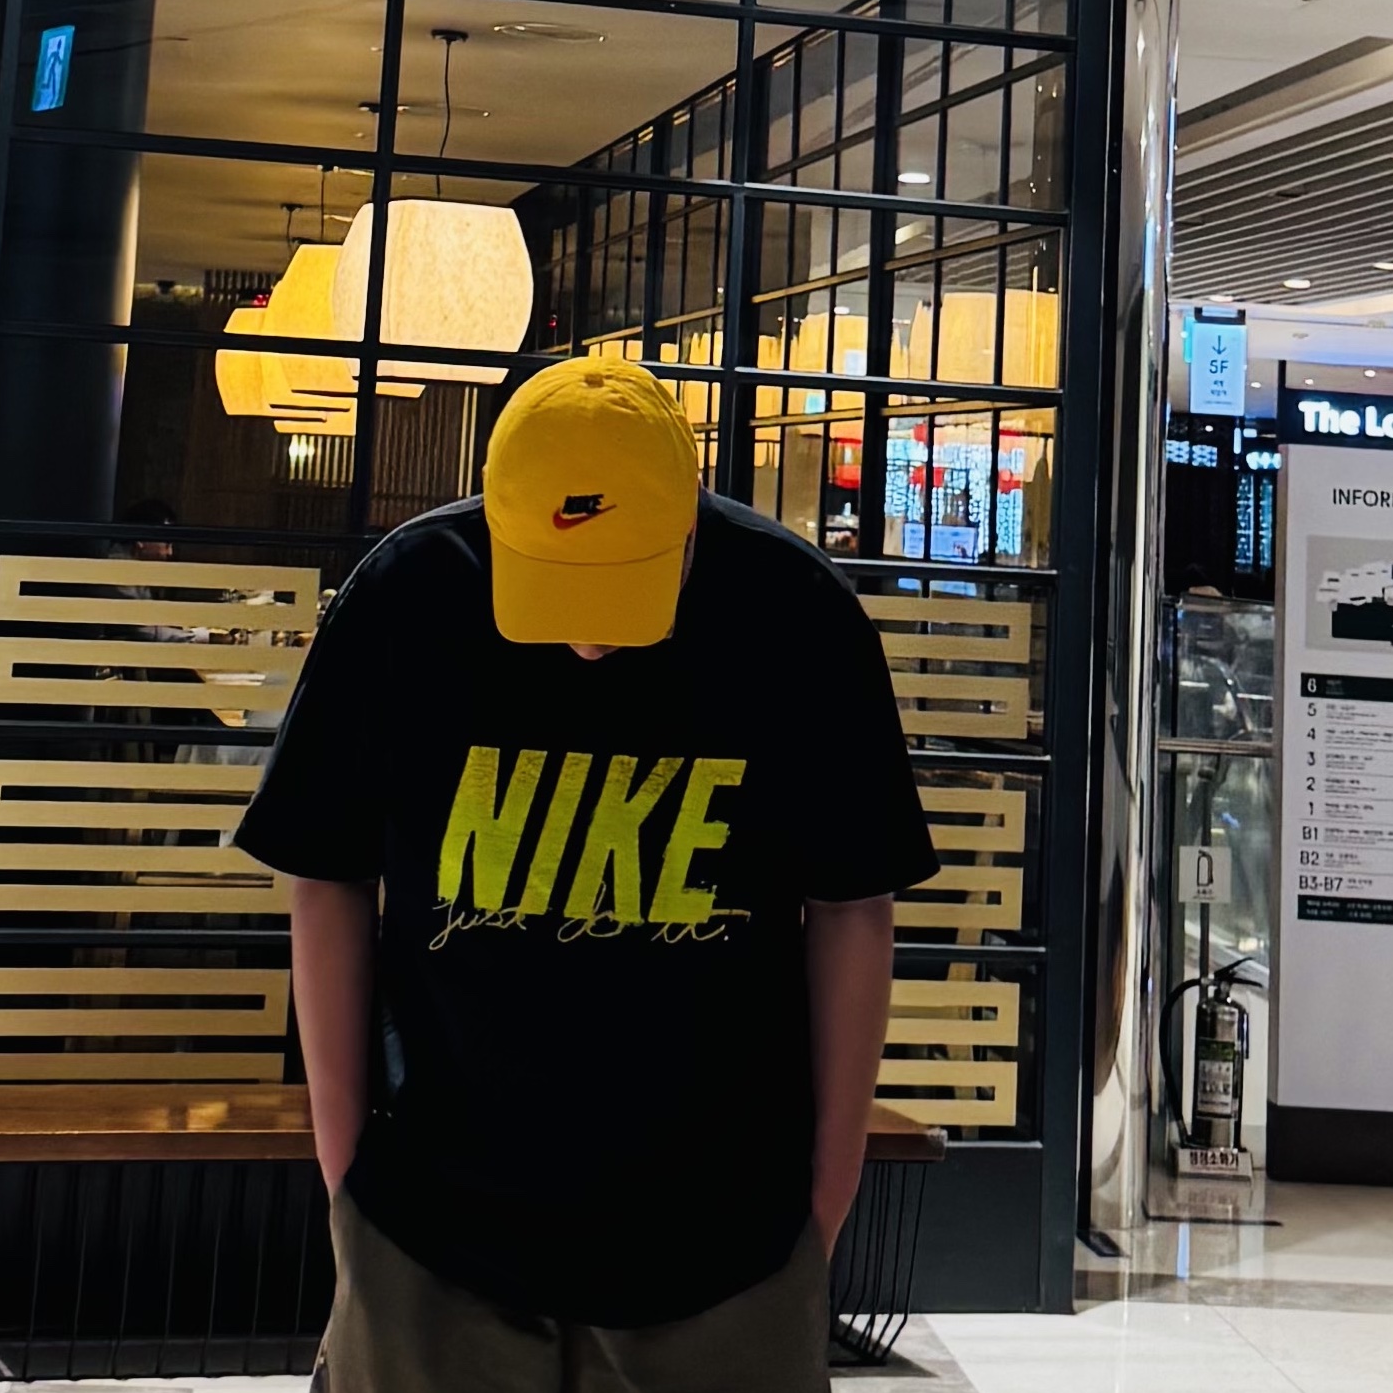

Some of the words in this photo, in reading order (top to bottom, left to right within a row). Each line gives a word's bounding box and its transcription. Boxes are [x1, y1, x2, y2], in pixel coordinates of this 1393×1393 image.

[1209, 359, 1229, 375] 5F
[1298, 400, 1360, 436] The
[1307, 702, 1317, 717] 5
[1306, 728, 1316, 741] 4
[1307, 751, 1316, 767] 3
[1306, 776, 1316, 792] 2
[1308, 801, 1314, 816] 1
[438, 746, 747, 924] NIKE
[1302, 825, 1318, 841] B1
[1300, 850, 1320, 867] B2
